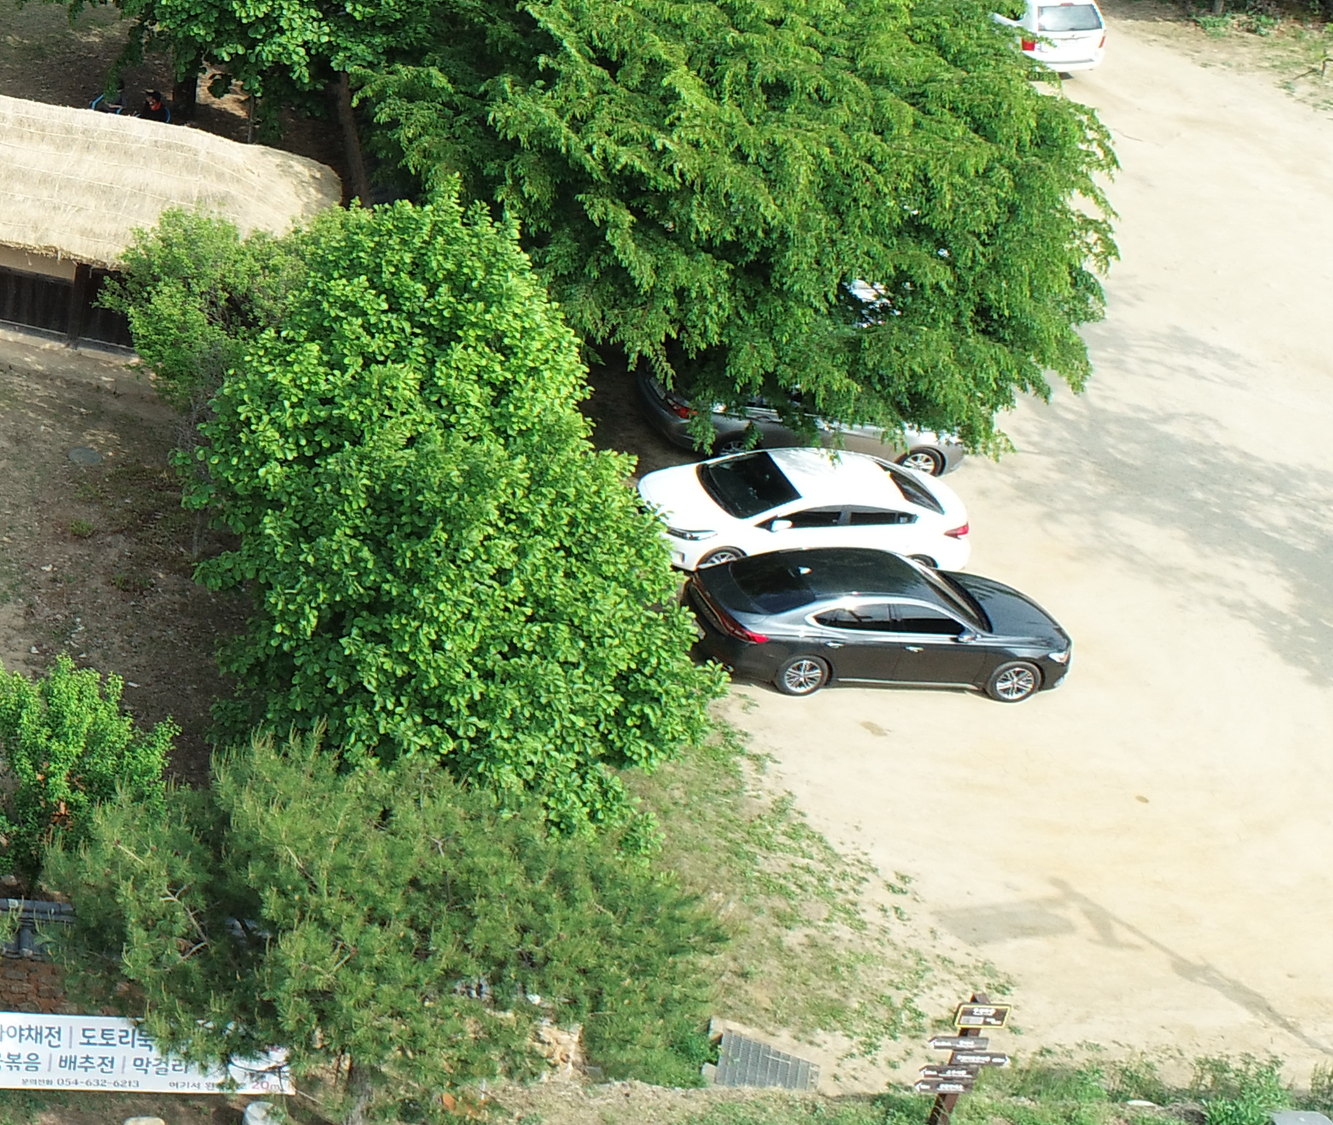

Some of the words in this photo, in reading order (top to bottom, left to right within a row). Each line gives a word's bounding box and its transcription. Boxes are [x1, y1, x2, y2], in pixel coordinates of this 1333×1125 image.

[58, 1054, 115, 1074] 배추전
[132, 1056, 189, 1076] 막걸리
[56, 1078, 140, 1088] 054-632-6213
